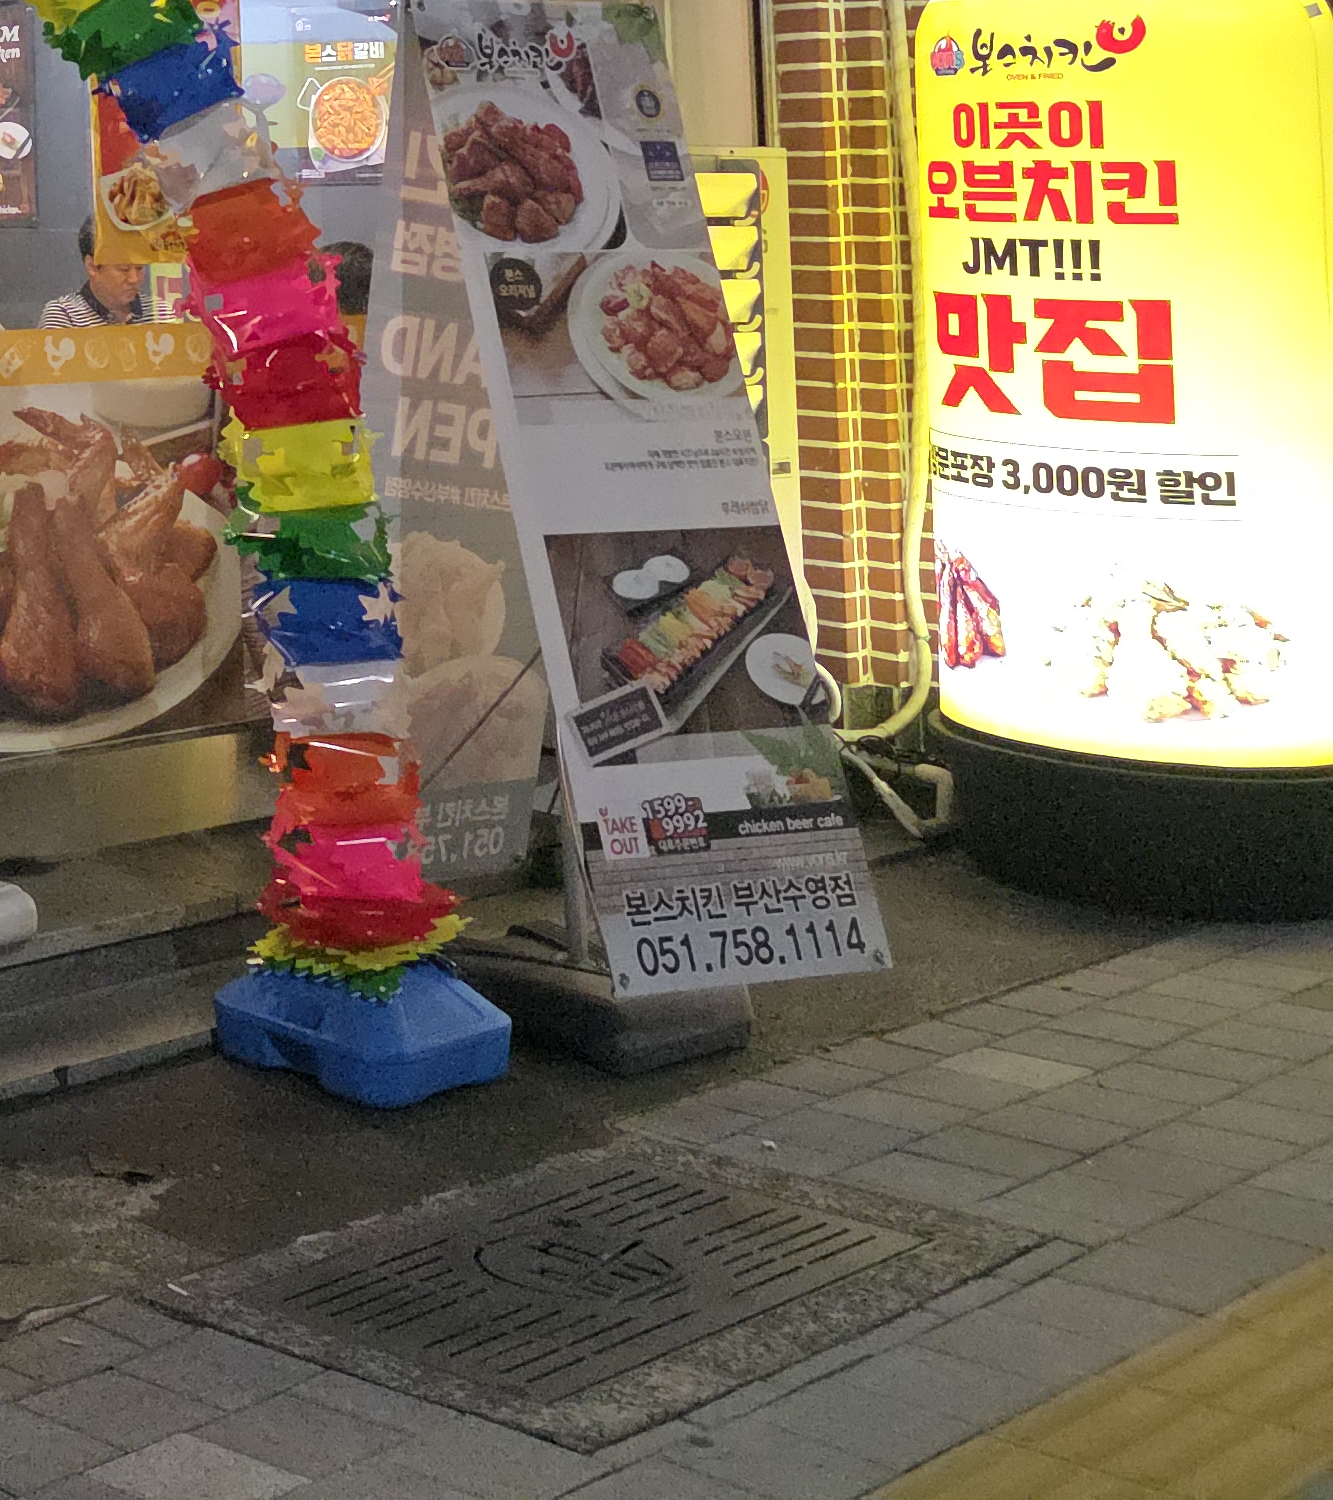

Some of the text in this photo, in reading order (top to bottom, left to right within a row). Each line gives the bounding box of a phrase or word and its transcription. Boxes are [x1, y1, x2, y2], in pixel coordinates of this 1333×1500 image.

[969, 27, 1118, 77] 본스치킨
[952, 100, 1105, 150] 이곳이
[927, 159, 1180, 225] 오븐치킨
[962, 236, 1102, 281] JMT!!!
[932, 290, 1176, 425] 맛집
[1001, 457, 1148, 504] 3,000원
[1155, 468, 1237, 508] 할인
[602, 816, 639, 836] TAKE
[609, 836, 640, 855] OUT
[661, 809, 708, 836] 9992
[738, 812, 844, 835] chicken beer cafe
[624, 872, 857, 927] 본스치킨 부산수영점
[636, 916, 867, 977] 051.758.1114
